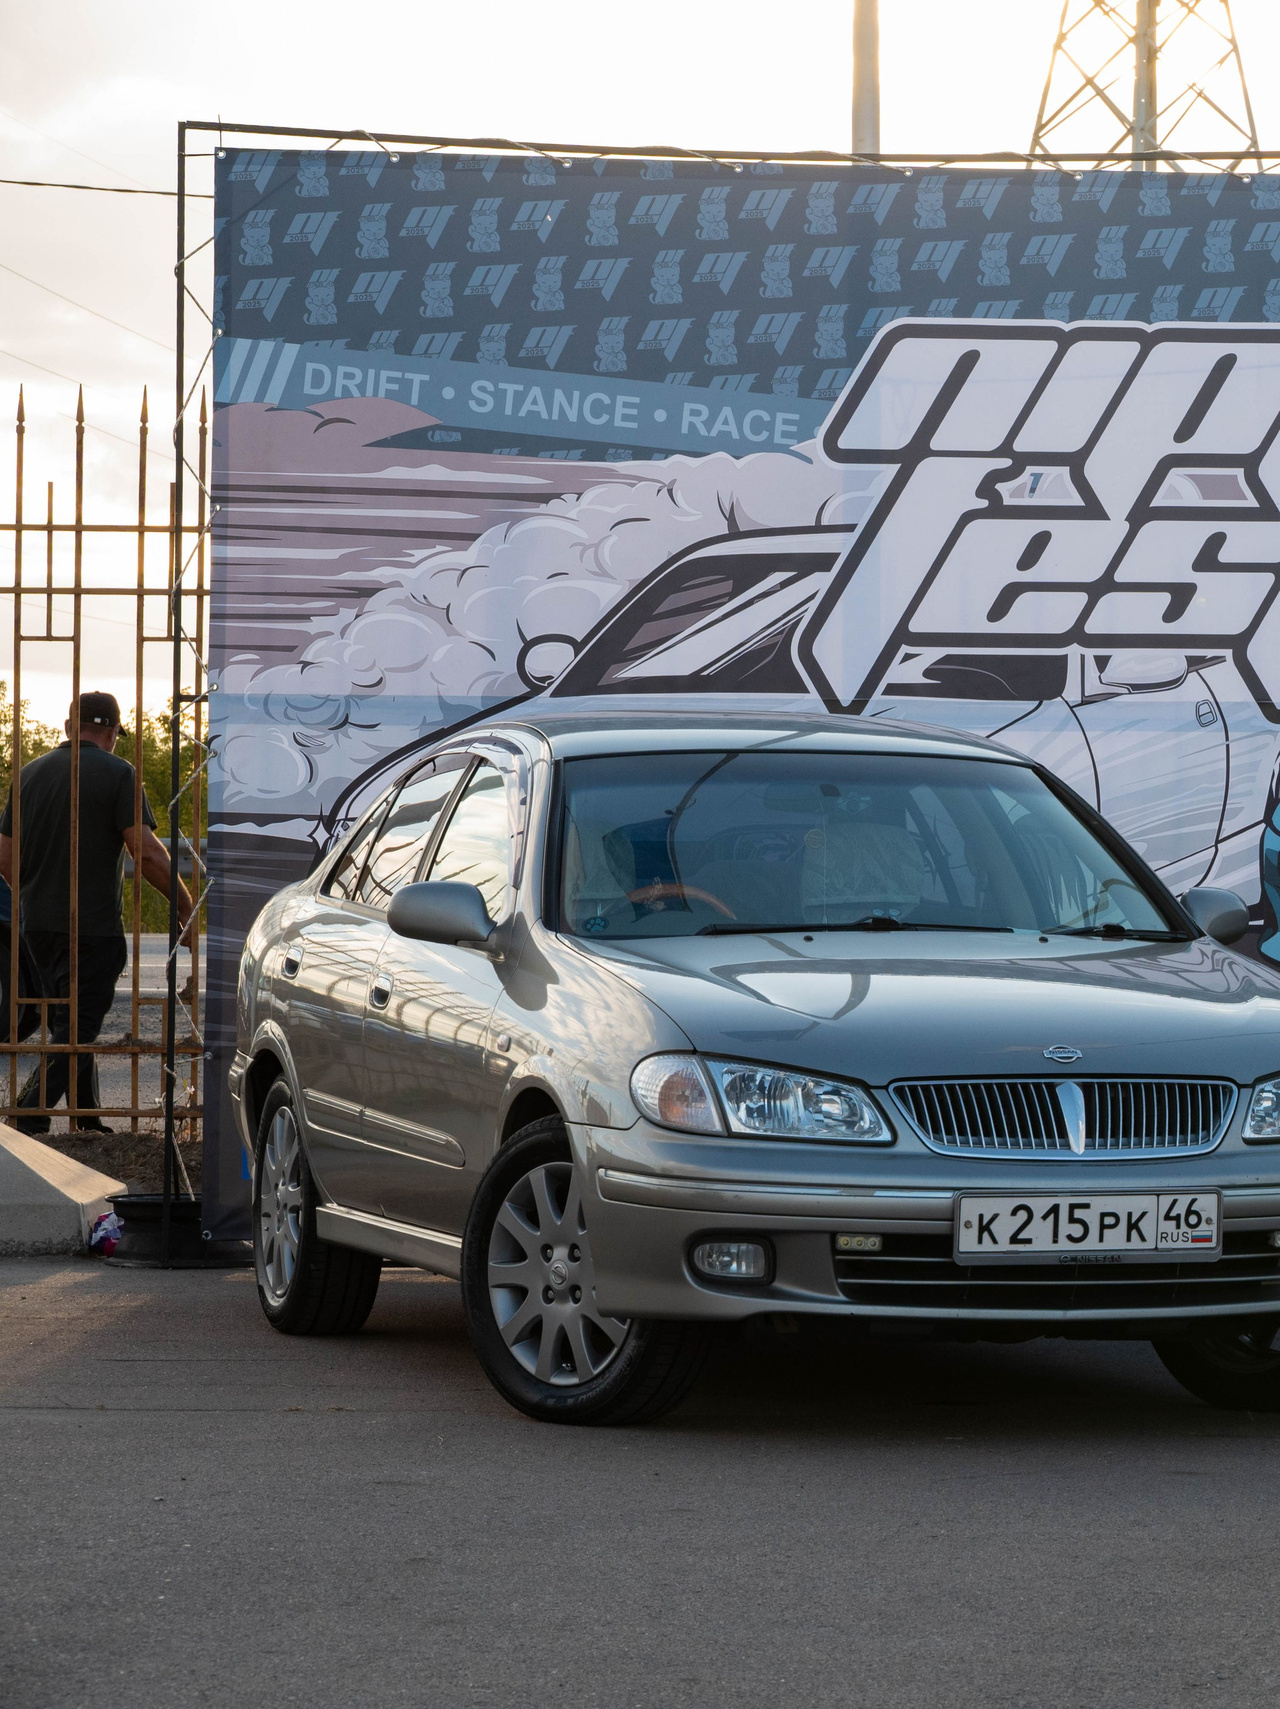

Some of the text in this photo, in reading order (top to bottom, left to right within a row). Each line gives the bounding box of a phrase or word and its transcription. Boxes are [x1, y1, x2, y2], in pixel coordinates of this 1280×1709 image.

[303, 362, 800, 446] DRIFT STANCE RACE
[1160, 1231, 1190, 1243] RUS
[1076, 1254, 1122, 1264] NISSAN
